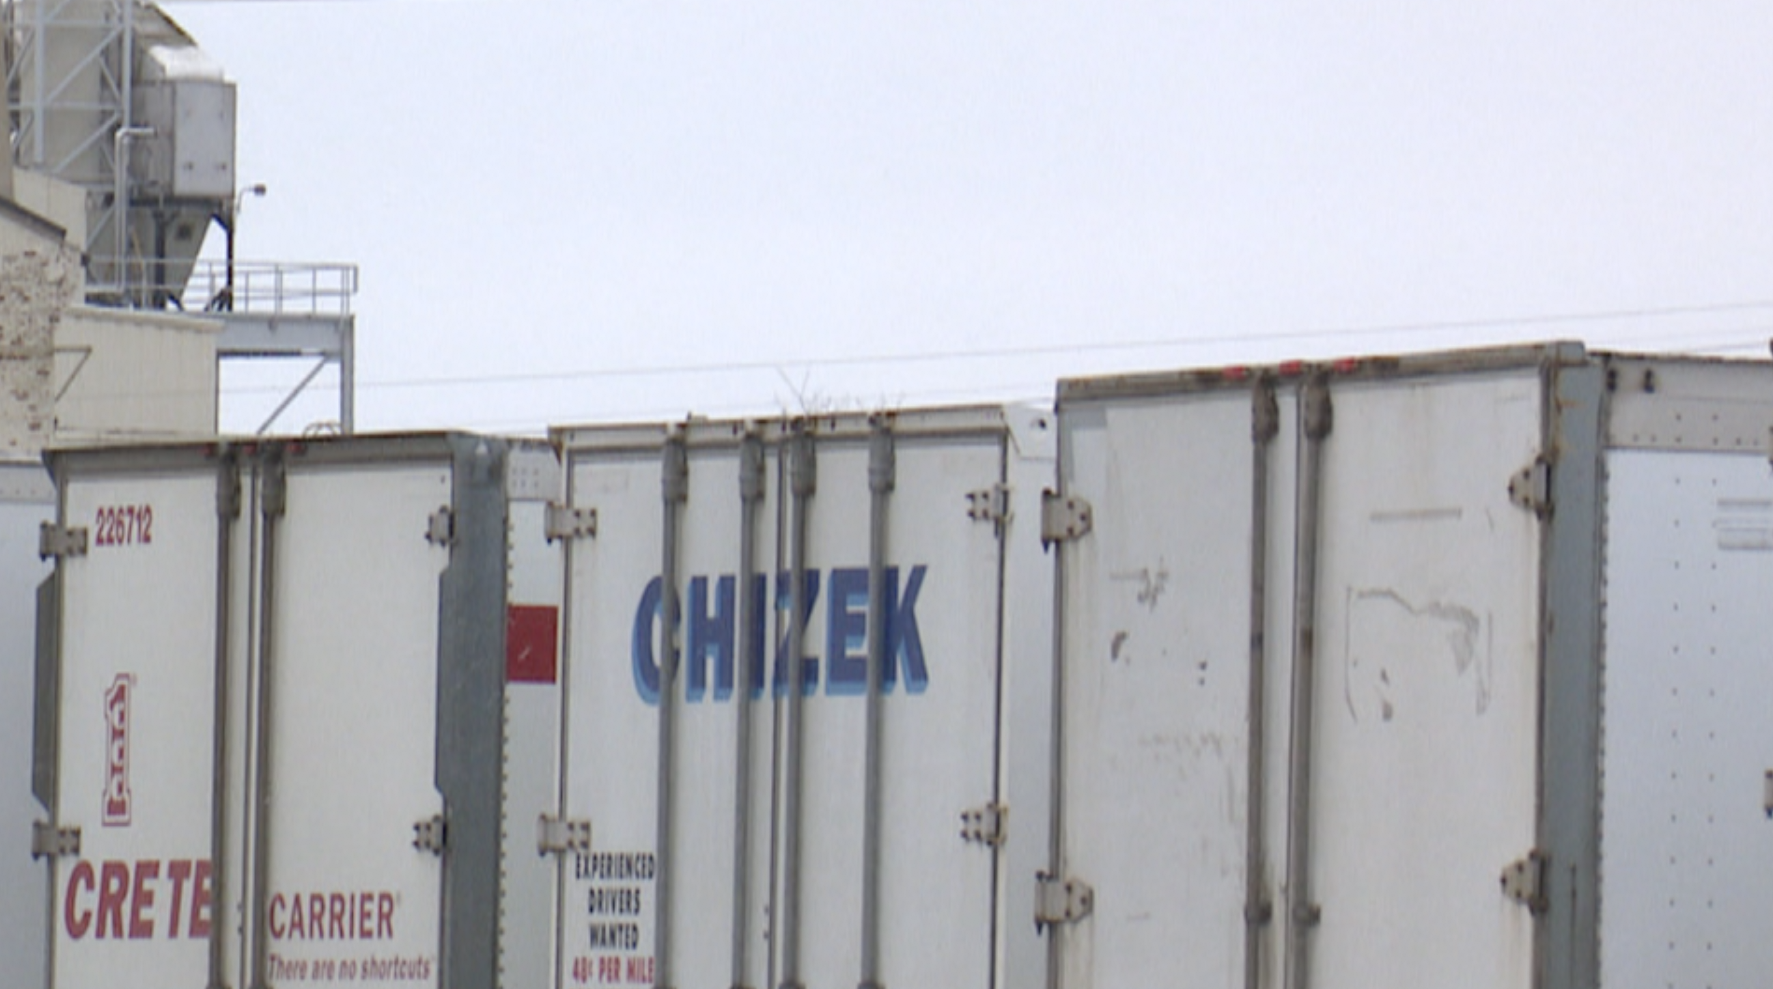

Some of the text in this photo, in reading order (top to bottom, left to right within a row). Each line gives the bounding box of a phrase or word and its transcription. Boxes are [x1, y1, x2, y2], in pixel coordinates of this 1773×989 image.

[96, 505, 152, 546] 226712
[632, 565, 929, 706] CHIZEK
[575, 852, 655, 880] EXPERIENCED
[64, 859, 394, 940] CRETE CARRIER
[588, 888, 641, 915] DRIVERS
[589, 922, 639, 950] WANTED
[269, 953, 432, 981] There are no shortcuts
[598, 956, 621, 984] PER
[626, 956, 655, 985] MILE
